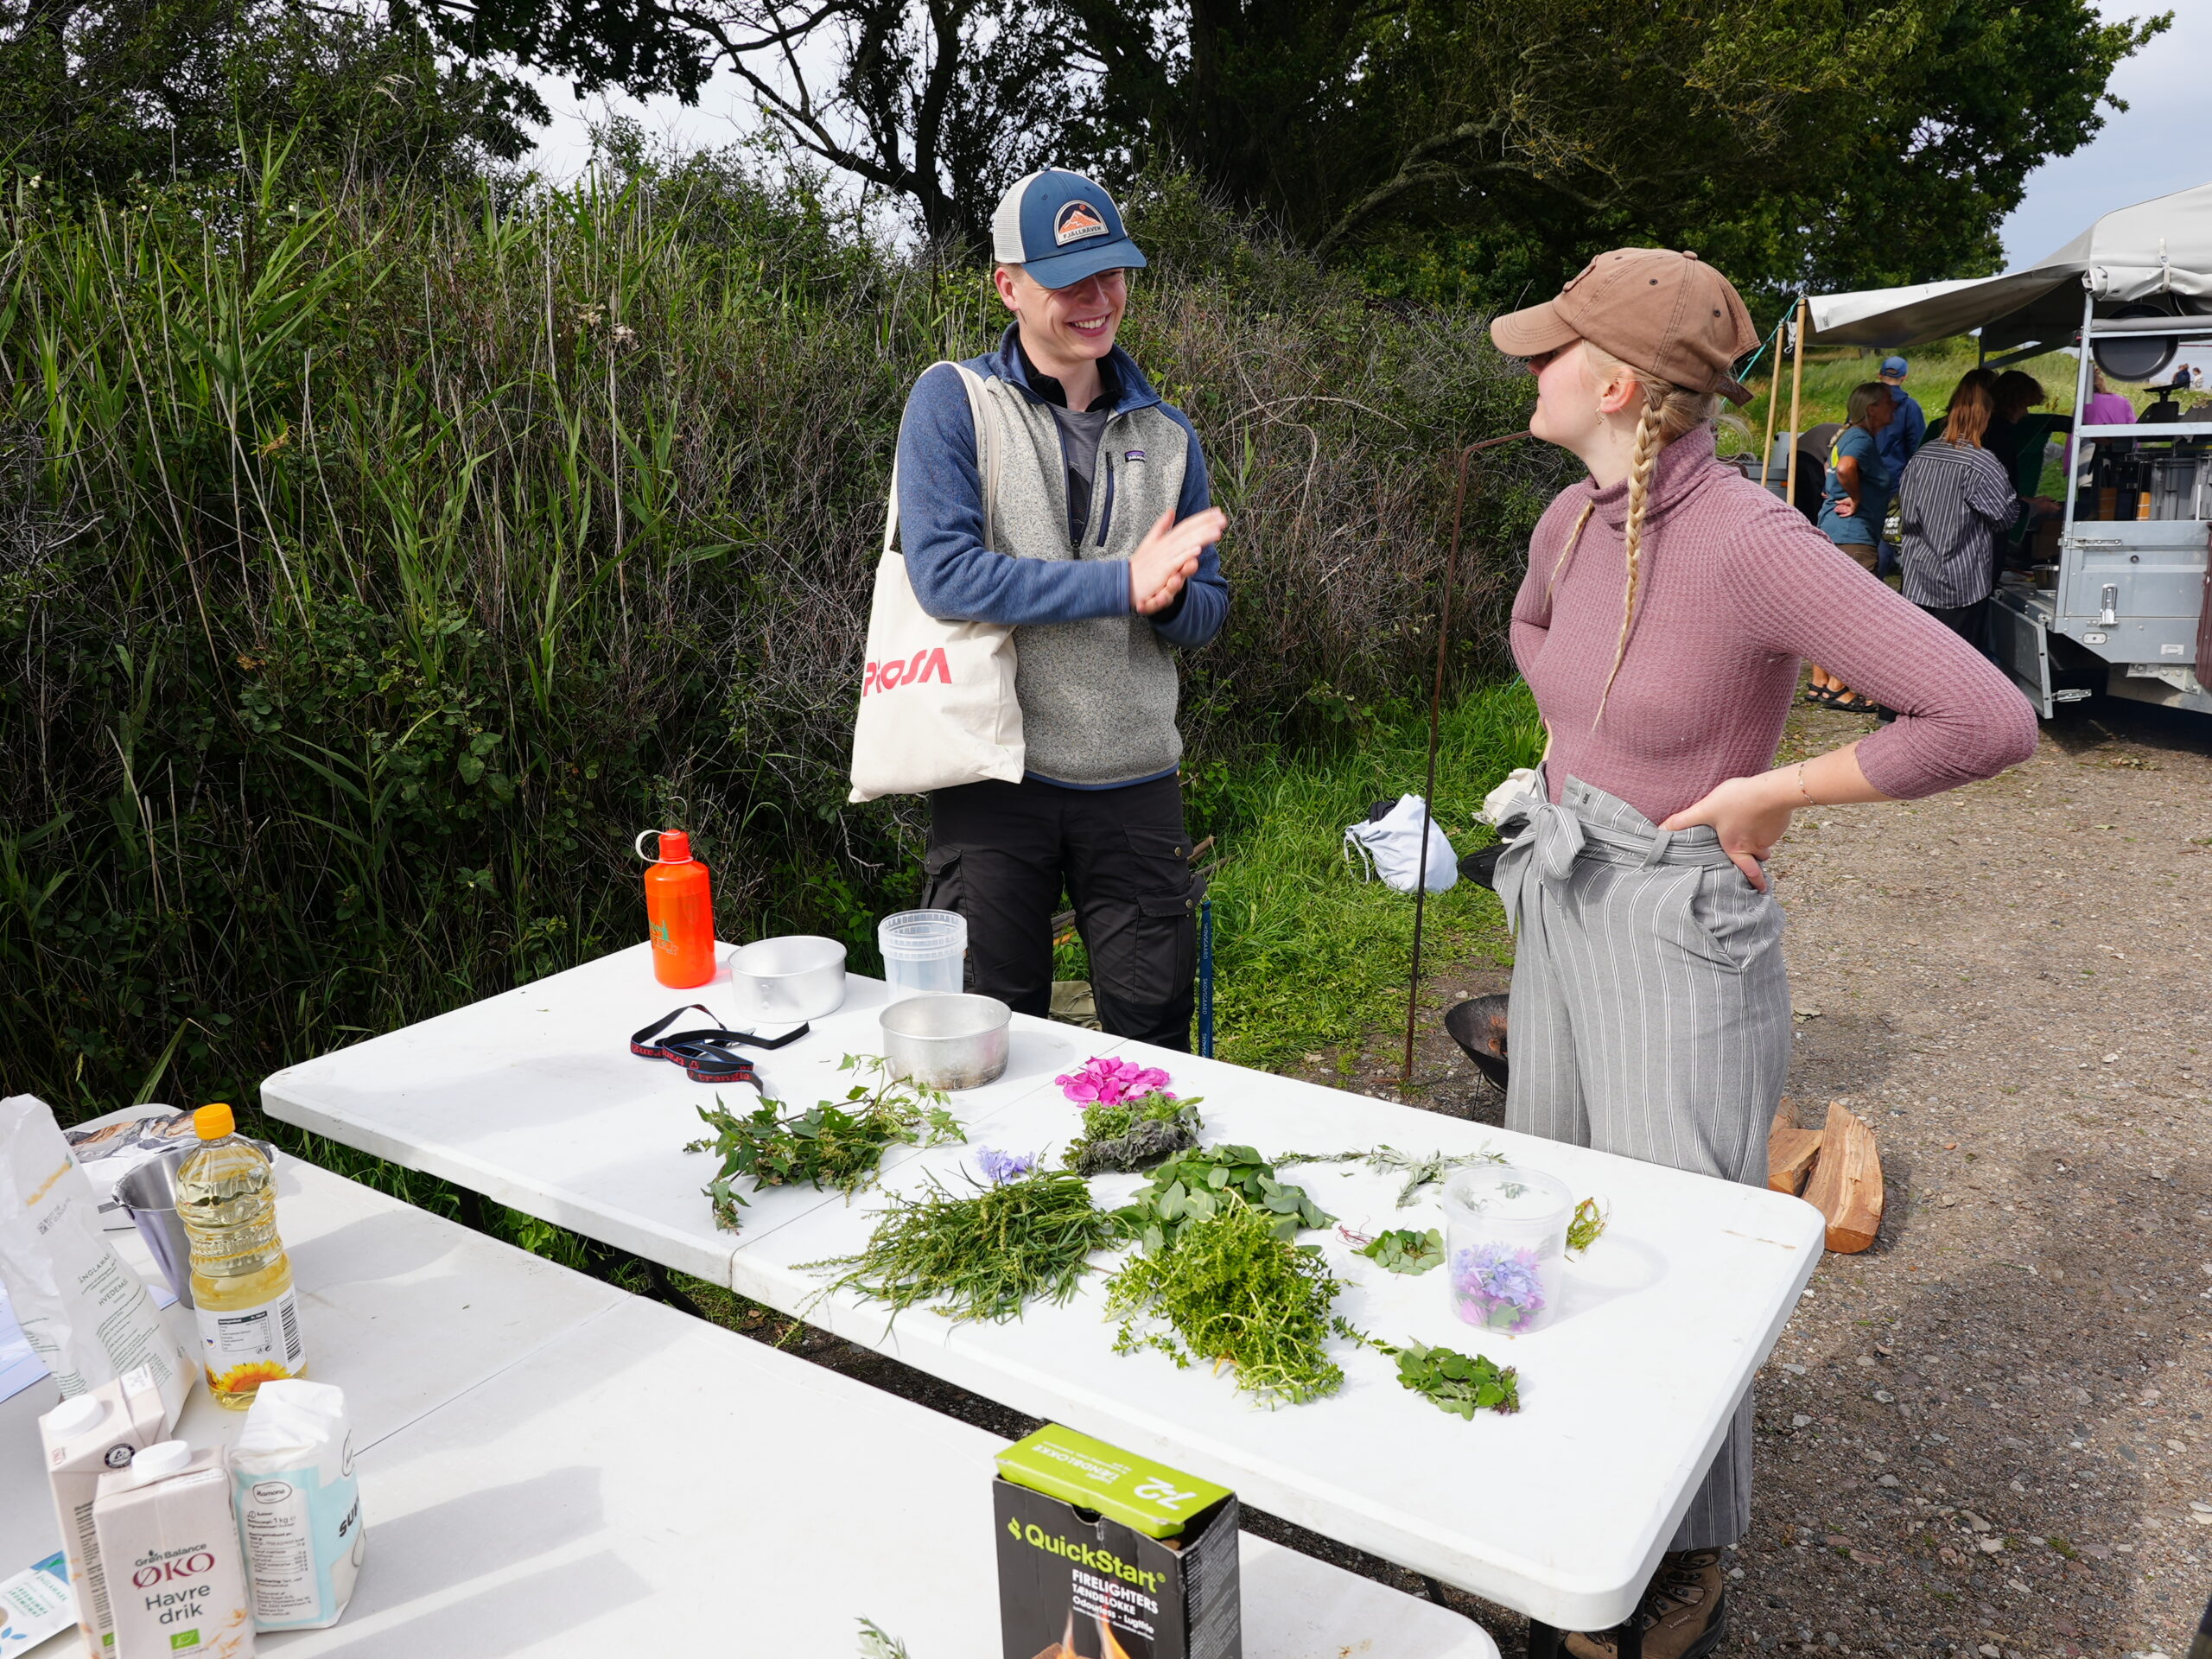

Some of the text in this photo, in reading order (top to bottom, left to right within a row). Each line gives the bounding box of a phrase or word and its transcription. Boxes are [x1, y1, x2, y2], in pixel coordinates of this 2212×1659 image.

[698, 1071, 751, 1082] trangia
[135, 1543, 207, 1567] Grøn Balance
[1025, 1523, 1157, 1593] QuickStart
[132, 1553, 215, 1590] ØKO
[145, 1585, 211, 1611] Havre
[1072, 1568, 1159, 1614] FIRELIGHTERS
[1072, 1583, 1135, 1615] TÆNDBLOKKE
[159, 1603, 203, 1624] drik
[1072, 1595, 1116, 1618] Odourless
